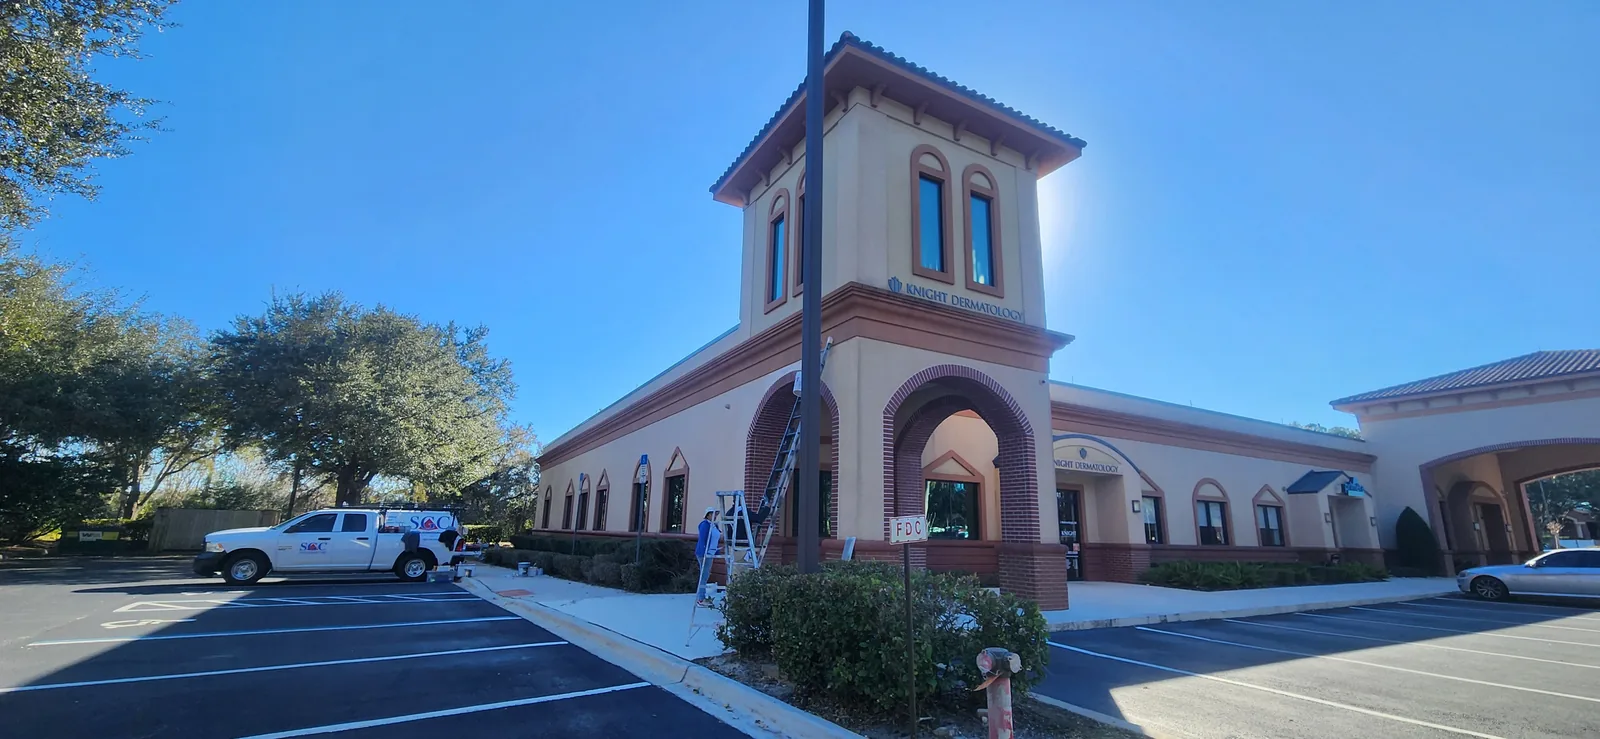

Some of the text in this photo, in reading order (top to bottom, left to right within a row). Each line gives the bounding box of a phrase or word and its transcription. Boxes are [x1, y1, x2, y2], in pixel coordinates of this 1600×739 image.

[906, 282, 1023, 321] KNIGHT DERMATOLOGY
[1053, 459, 1119, 473] NIGHT DERMATOLOGY
[896, 521, 921, 536] FDC
